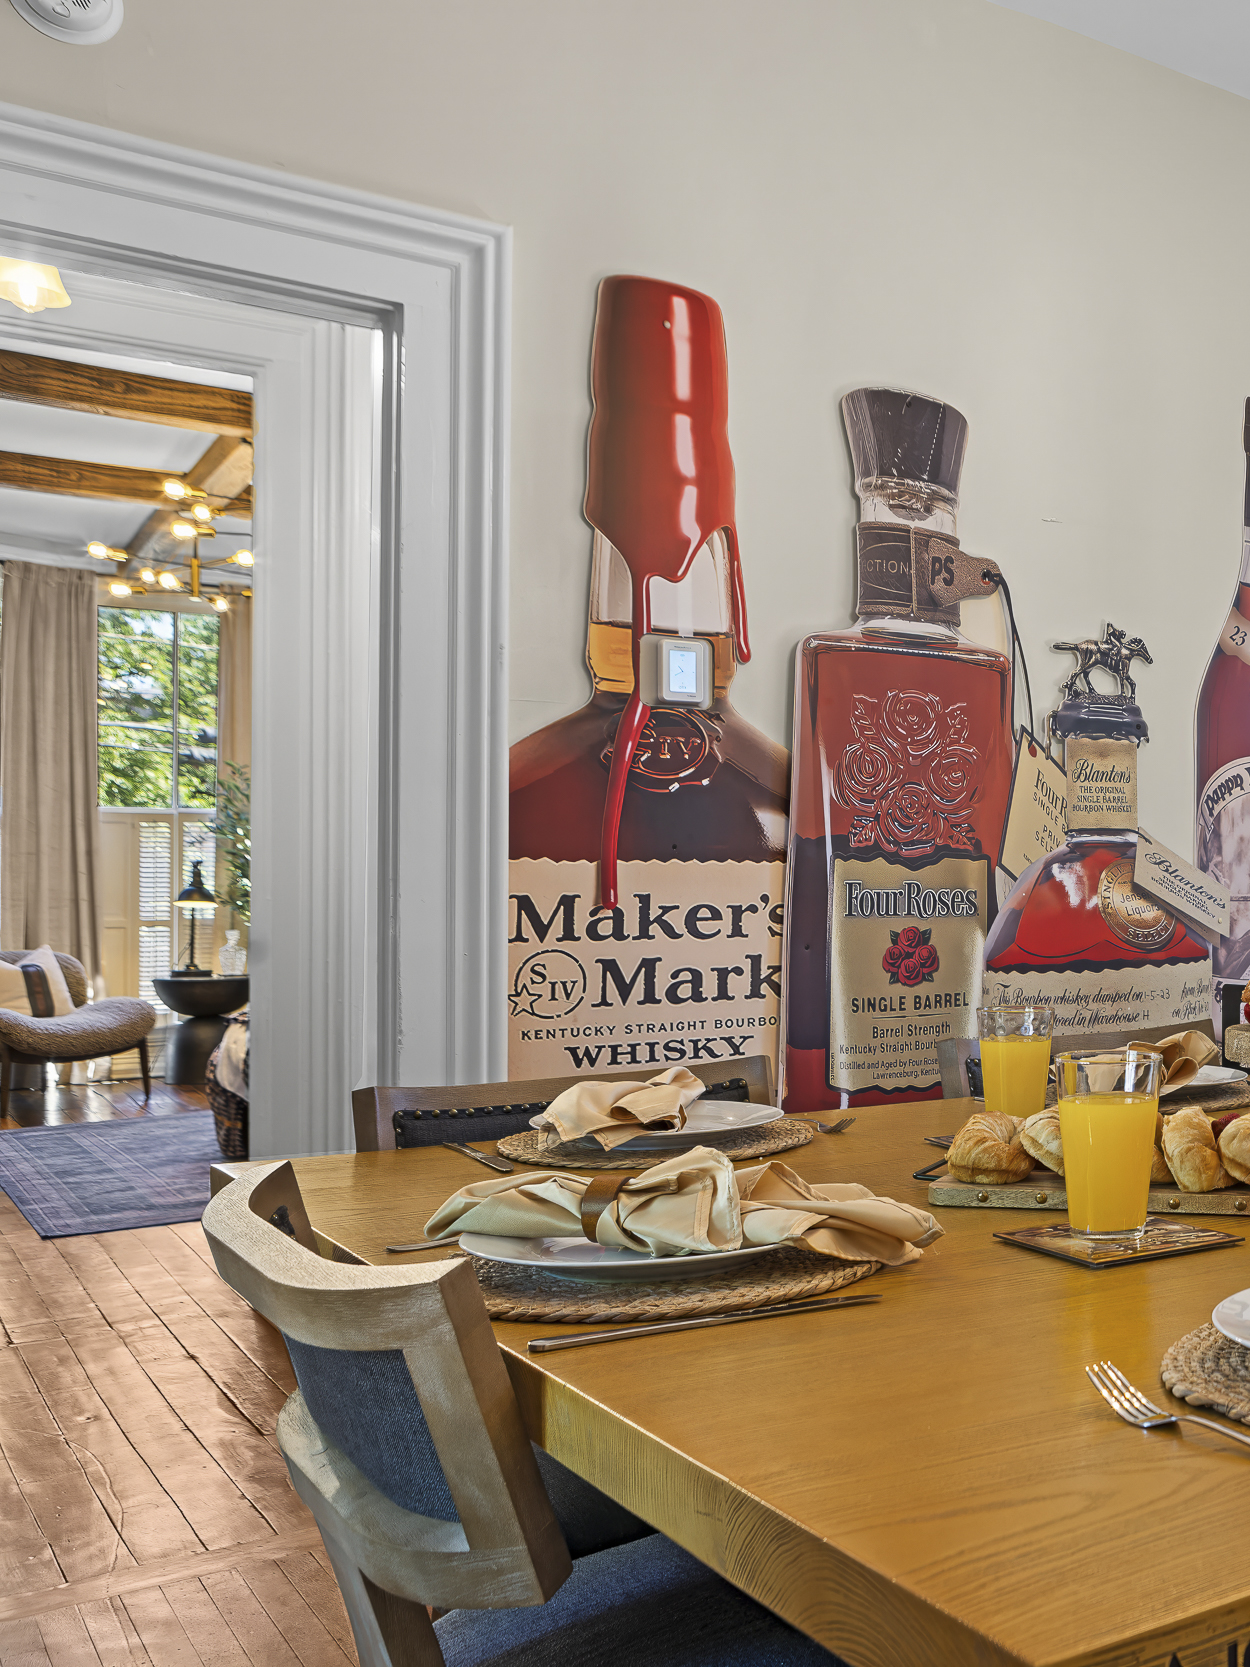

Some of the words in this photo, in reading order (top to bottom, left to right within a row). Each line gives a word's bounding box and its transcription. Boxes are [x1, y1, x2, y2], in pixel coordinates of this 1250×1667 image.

[931, 556, 955, 586] PS
[1229, 625, 1248, 647] 23
[1072, 758, 1131, 784] Blanton's
[1076, 794, 1101, 804] SINGLE
[1079, 785, 1094, 794] THE
[1095, 786, 1126, 795] ORIGINAL
[1032, 791, 1059, 826] SINGLE
[1072, 804, 1104, 814] BOURBON
[1042, 824, 1061, 849] PRIV
[1144, 852, 1226, 910] Blanton's
[508, 892, 784, 944] Maker's
[1125, 902, 1161, 917] Liquors
[591, 953, 782, 1008] Mark
[851, 995, 907, 1013] SINGLE
[913, 991, 970, 1011] BARREL
[1012, 988, 1053, 1007] Bourbon
[1053, 987, 1092, 1011] whiskey
[1092, 985, 1133, 1008] dumped
[521, 1025, 616, 1041] KENTUCKY
[624, 1020, 707, 1035] STRAIGHT
[714, 1015, 781, 1029] BOURBO
[872, 1024, 904, 1039] Barrel
[907, 1021, 952, 1038] Strength
[1053, 1009, 1076, 1030] tored
[564, 1035, 754, 1069] WHISKY
[839, 1043, 878, 1056] Kentucky
[880, 1041, 913, 1054] Straight
[914, 1039, 938, 1051] Bourb
[839, 1060, 866, 1071] Distilled
[866, 1059, 880, 1070] and
[880, 1059, 898, 1071] Aged
[899, 1058, 908, 1069] by
[908, 1058, 923, 1067] Four
[923, 1056, 938, 1066] Rose
[920, 1067, 941, 1077] Kentu
